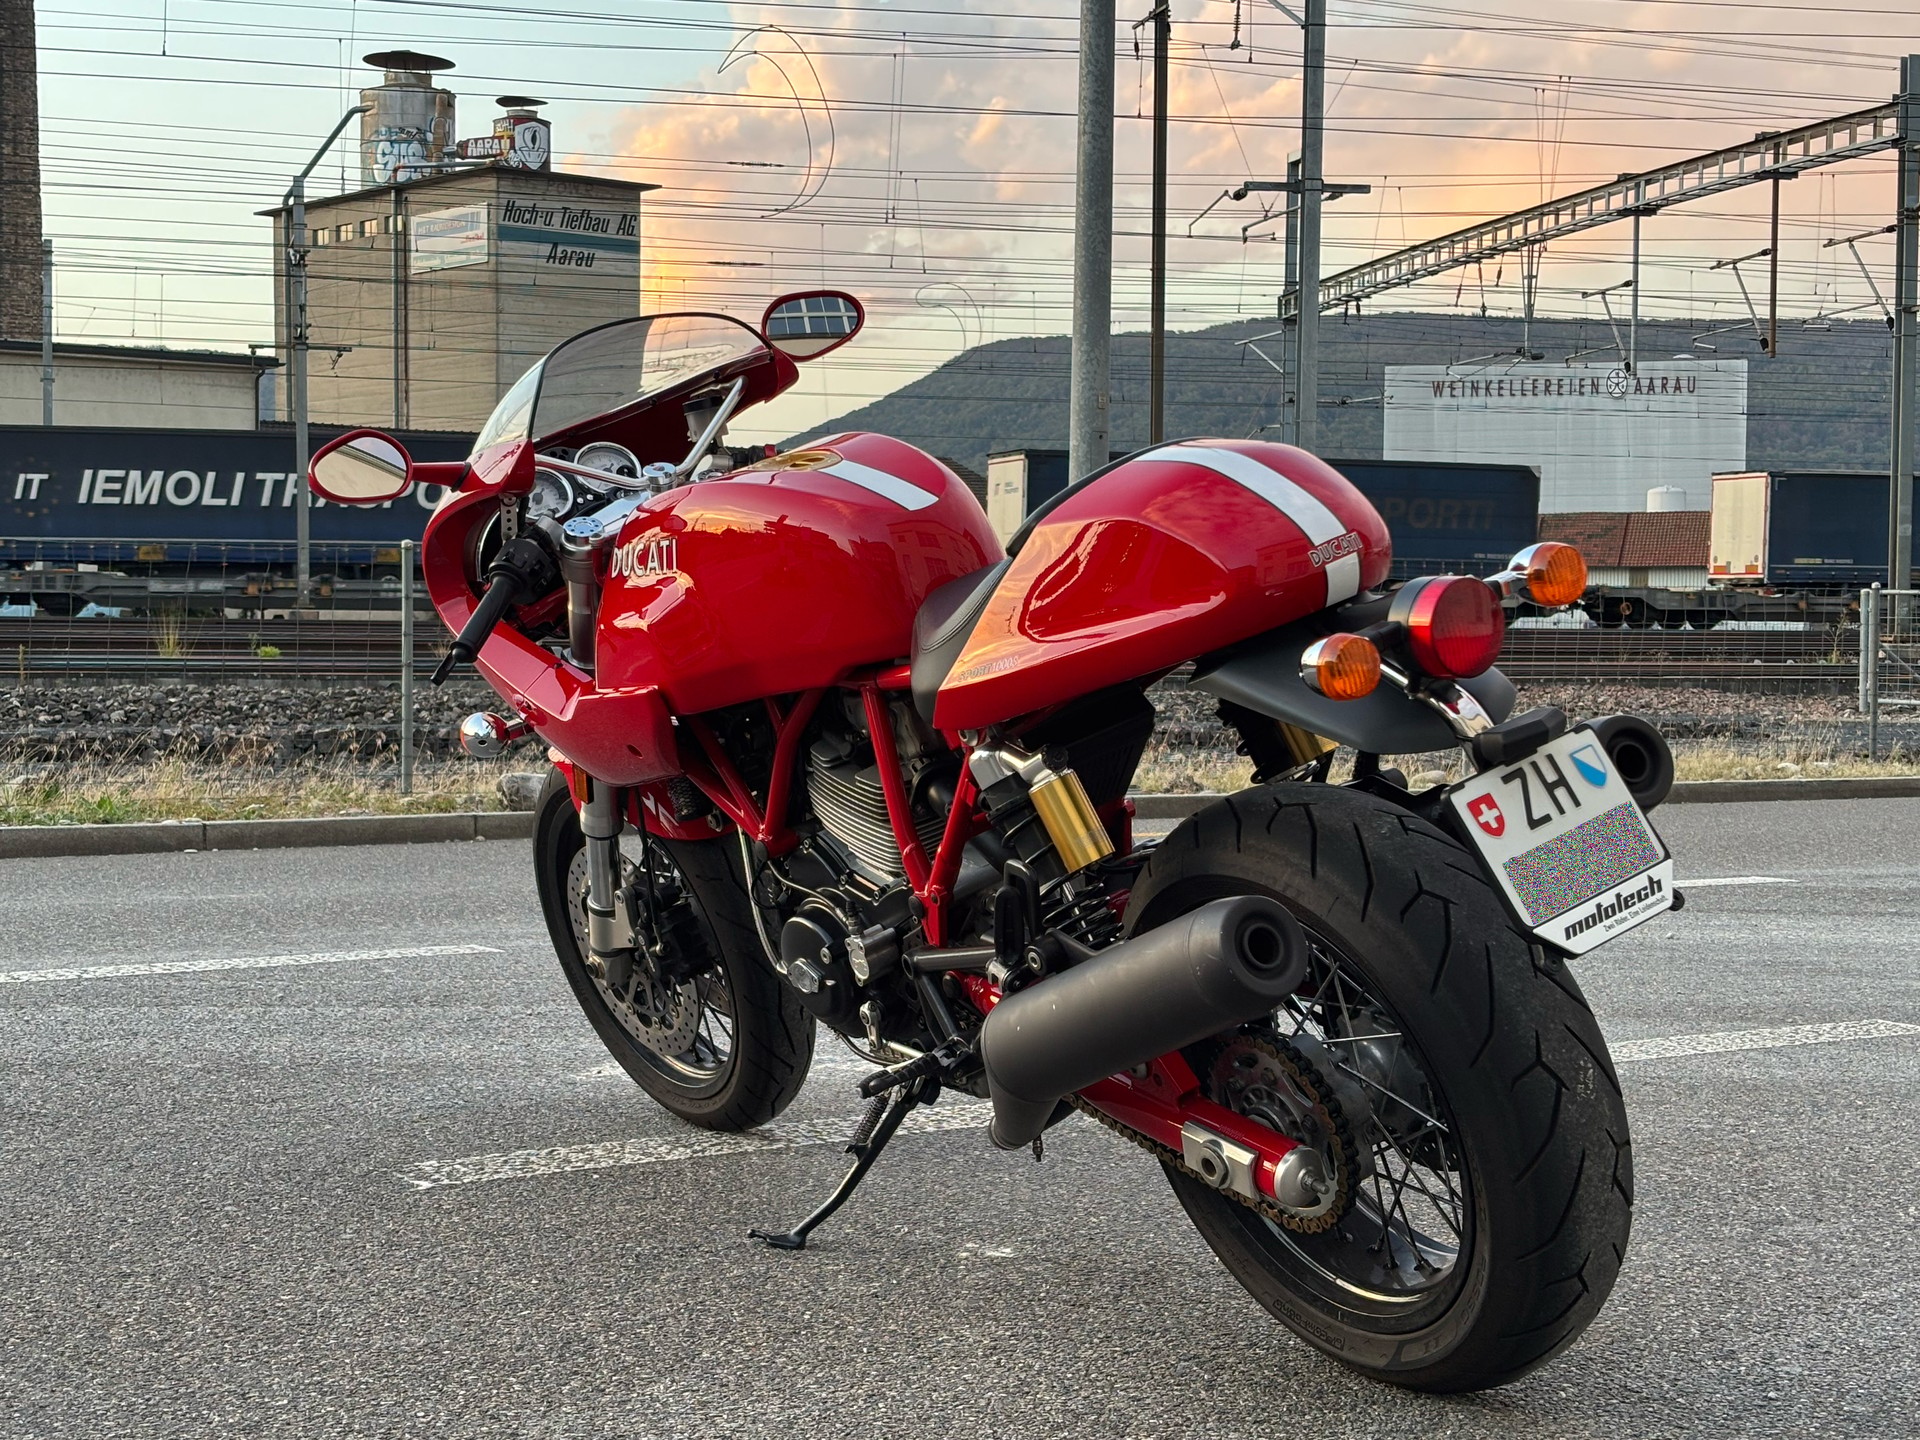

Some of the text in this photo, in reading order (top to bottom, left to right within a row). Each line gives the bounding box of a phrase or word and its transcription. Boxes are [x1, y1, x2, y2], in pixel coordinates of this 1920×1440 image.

[560, 206, 611, 233] Tiefbau
[546, 242, 596, 268] Aarau
[1432, 376, 1697, 398] WEINKELLEREIEN AARAU
[14, 473, 49, 500] IT
[78, 468, 246, 507] IEMOLI
[611, 537, 679, 579] DUCATI
[1308, 531, 1363, 568] DUCATI
[1500, 753, 1582, 831] ZH
[1564, 874, 1663, 942] mototech
